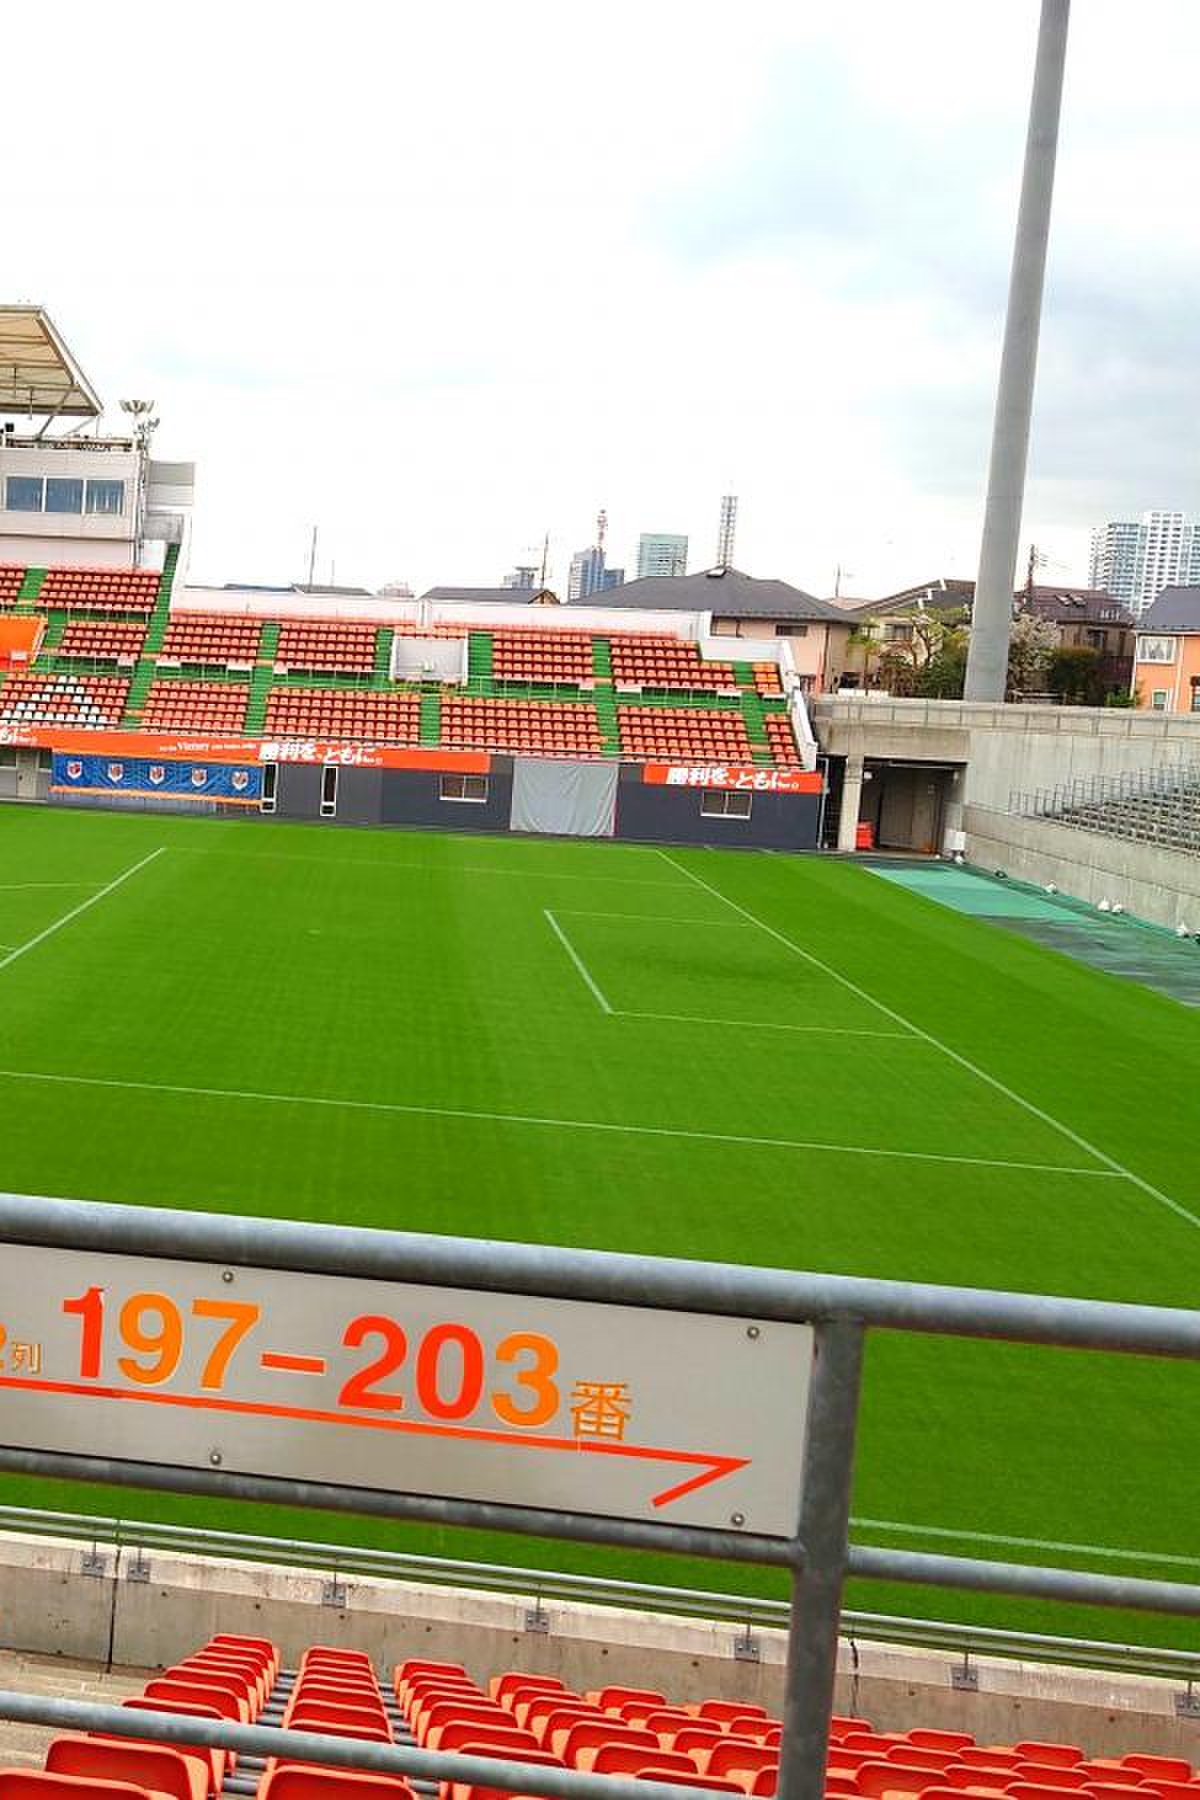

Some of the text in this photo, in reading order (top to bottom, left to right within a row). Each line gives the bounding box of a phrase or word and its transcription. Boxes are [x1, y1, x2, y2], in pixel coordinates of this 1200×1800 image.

[666, 767, 800, 791] 勝利を、ともに。
